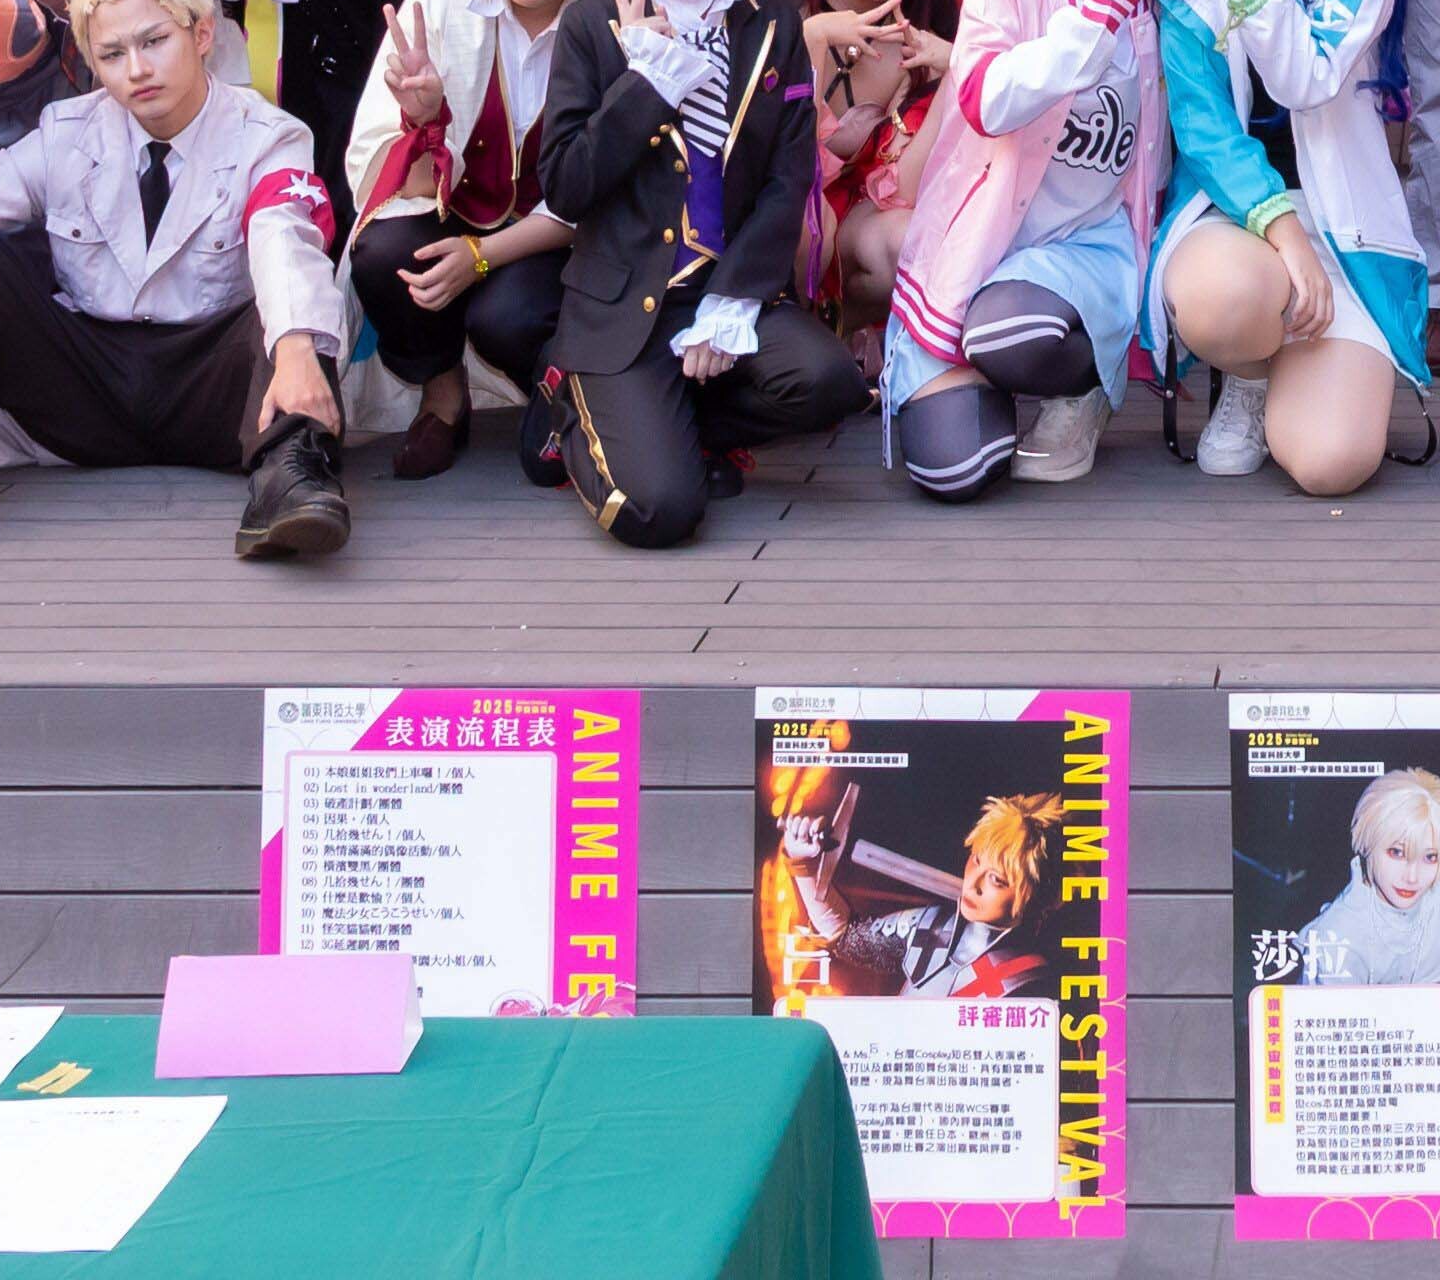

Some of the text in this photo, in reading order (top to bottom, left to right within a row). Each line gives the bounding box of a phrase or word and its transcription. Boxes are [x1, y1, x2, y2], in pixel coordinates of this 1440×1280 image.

[1052, 85, 1137, 177] mile
[471, 699, 513, 715] 2025
[385, 716, 557, 749] 表演流程表
[773, 722, 808, 737] 2025
[1248, 732, 1283, 746] 2025
[324, 783, 348, 794] Lost
[356, 783, 367, 794] in
[569, 708, 620, 900] ANIME
[1058, 709, 1111, 1220] ANIME FESTIVAL
[1250, 928, 1353, 983] 莎拉
[958, 1005, 1051, 1028] 評審簡介
